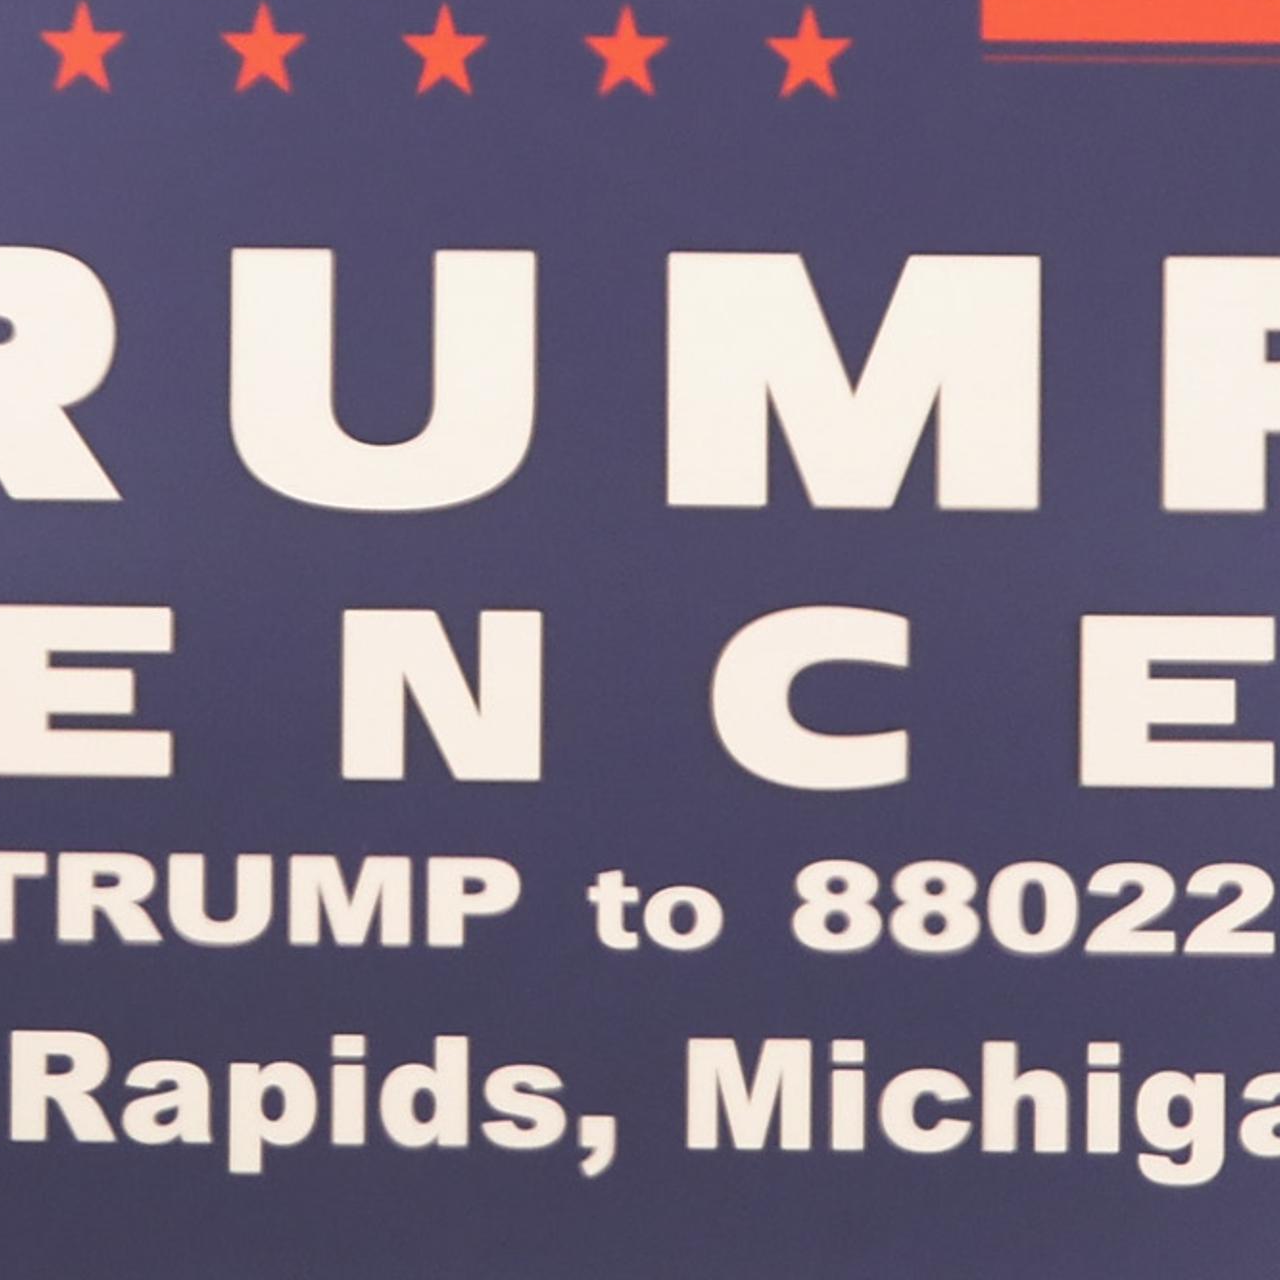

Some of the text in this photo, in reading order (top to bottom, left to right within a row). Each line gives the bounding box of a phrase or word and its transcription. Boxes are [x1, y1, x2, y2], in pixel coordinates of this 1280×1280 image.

[586, 869, 724, 952] to
[791, 858, 1277, 956] 88022
[9, 1029, 617, 1178] Rapids,
